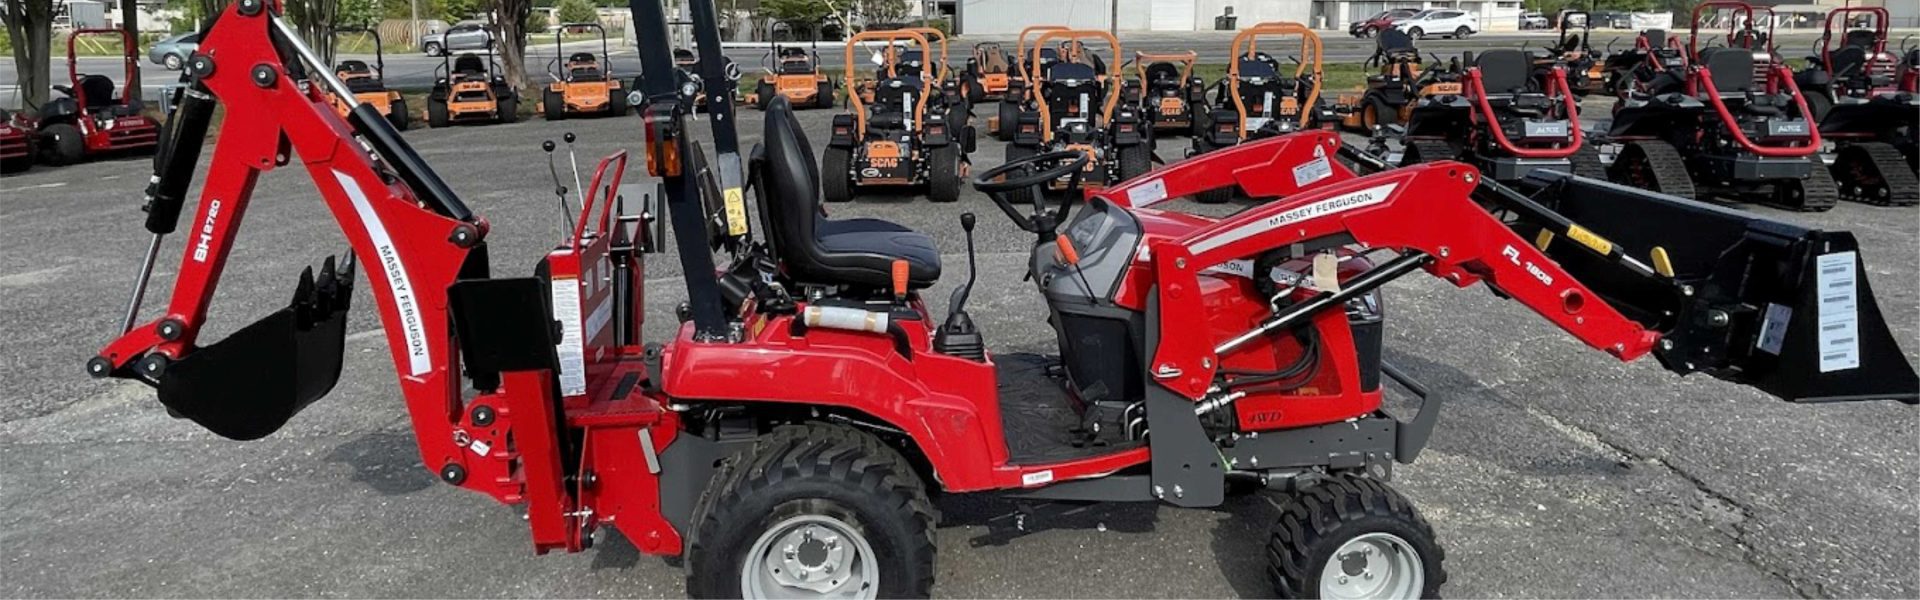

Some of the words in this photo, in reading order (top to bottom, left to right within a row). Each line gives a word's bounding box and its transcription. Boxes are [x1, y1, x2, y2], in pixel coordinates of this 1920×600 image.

[870, 157, 898, 168] SCAG
[1269, 207, 1312, 226] MASSEY
[1316, 193, 1373, 213] FERGUSON
[380, 244, 407, 292] MASSEY
[400, 294, 424, 357] FERGUSON
